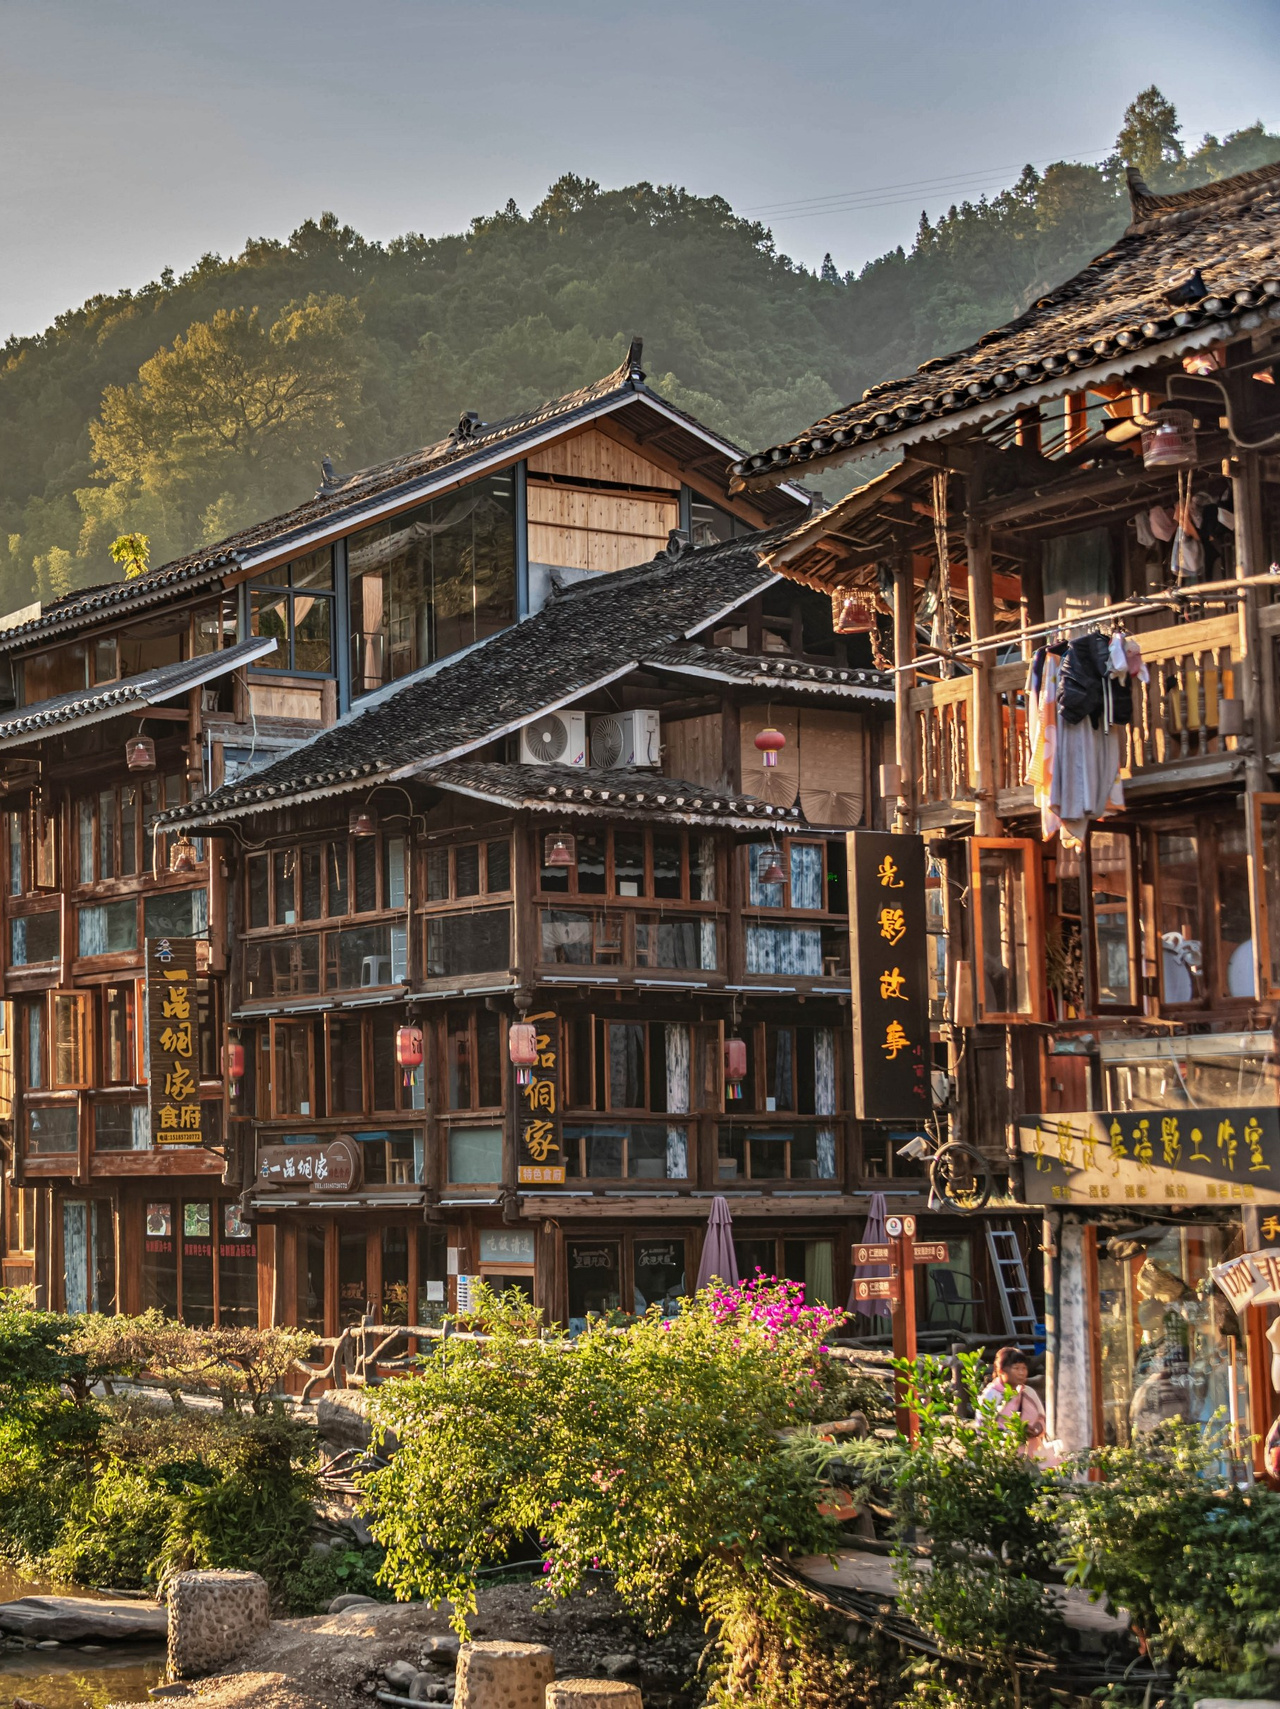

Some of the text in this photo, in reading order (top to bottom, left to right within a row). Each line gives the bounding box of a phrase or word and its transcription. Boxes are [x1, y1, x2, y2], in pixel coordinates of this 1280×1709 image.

[877, 855, 911, 1060] 光影故事
[158, 1104, 201, 1129] 食府
[523, 1167, 562, 1181] 特色食府
